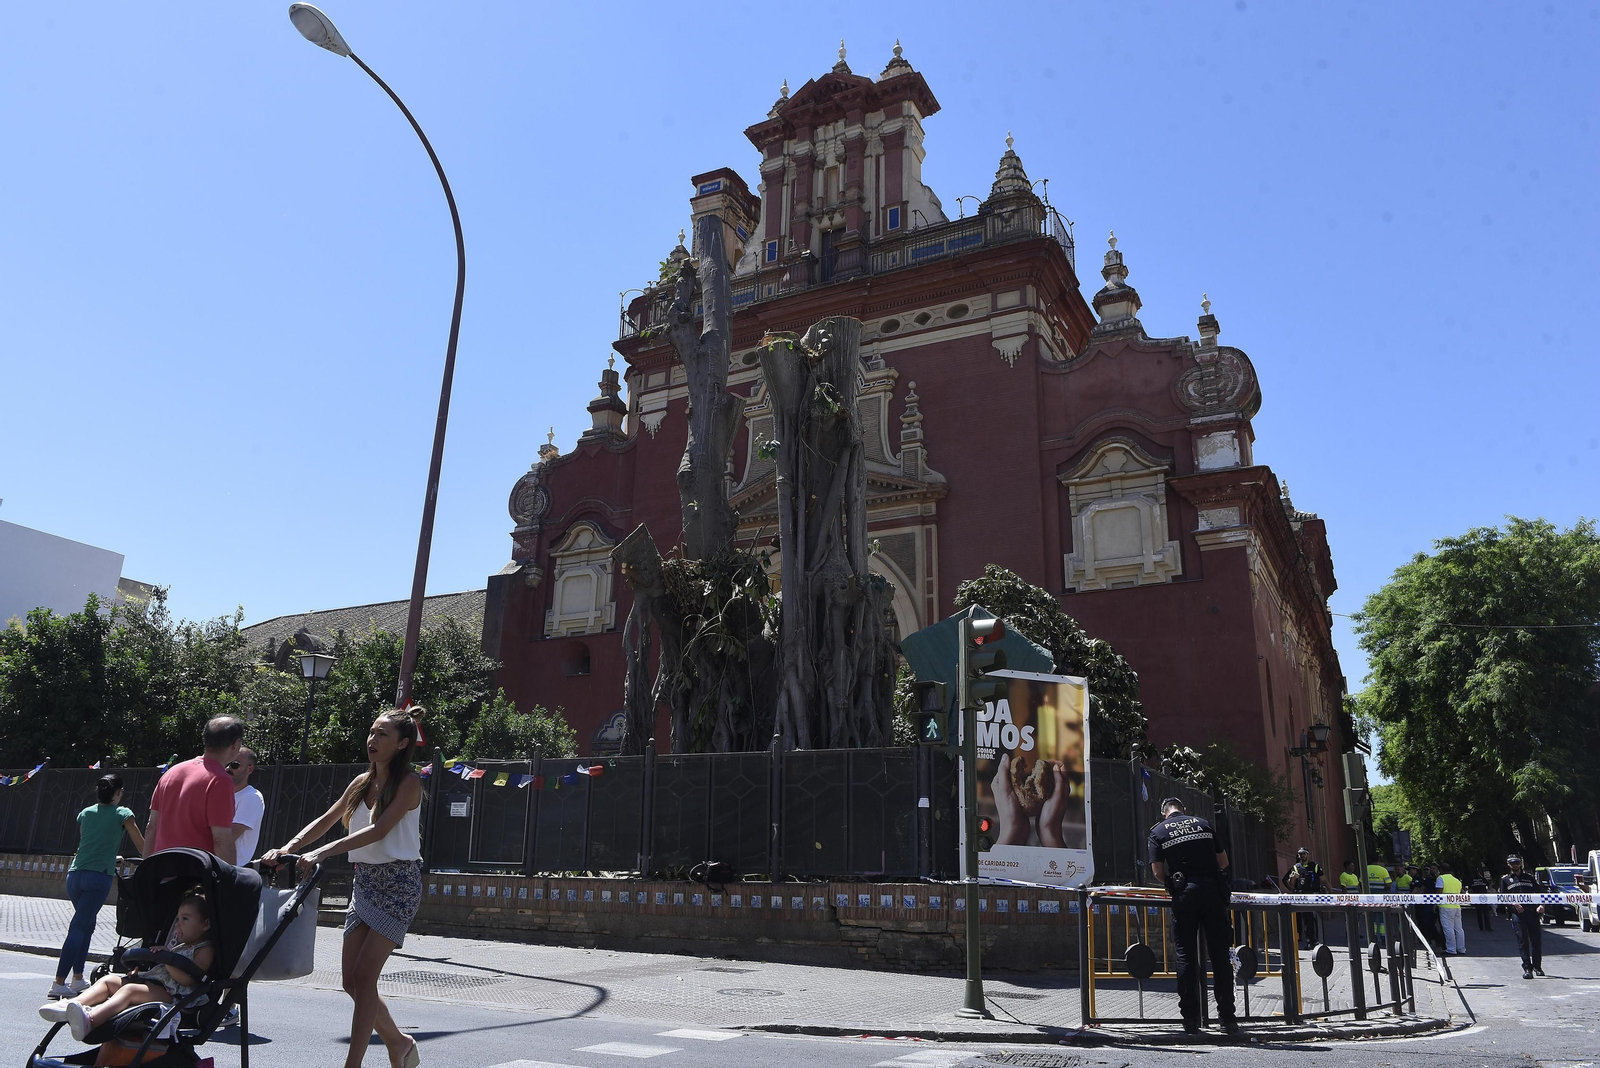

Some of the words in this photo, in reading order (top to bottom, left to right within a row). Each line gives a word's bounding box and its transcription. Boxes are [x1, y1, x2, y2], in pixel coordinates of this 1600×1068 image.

[977, 721, 1035, 751] MOS
[977, 747, 996, 755] SOMOS
[1168, 826, 1204, 838] SEVILLA
[1402, 894, 1416, 902] LOCAL
[1456, 895, 1472, 903] PASAR
[1517, 895, 1534, 903] LOCAL
[1566, 895, 1575, 903] NO
[1576, 895, 1594, 904] PASAR
